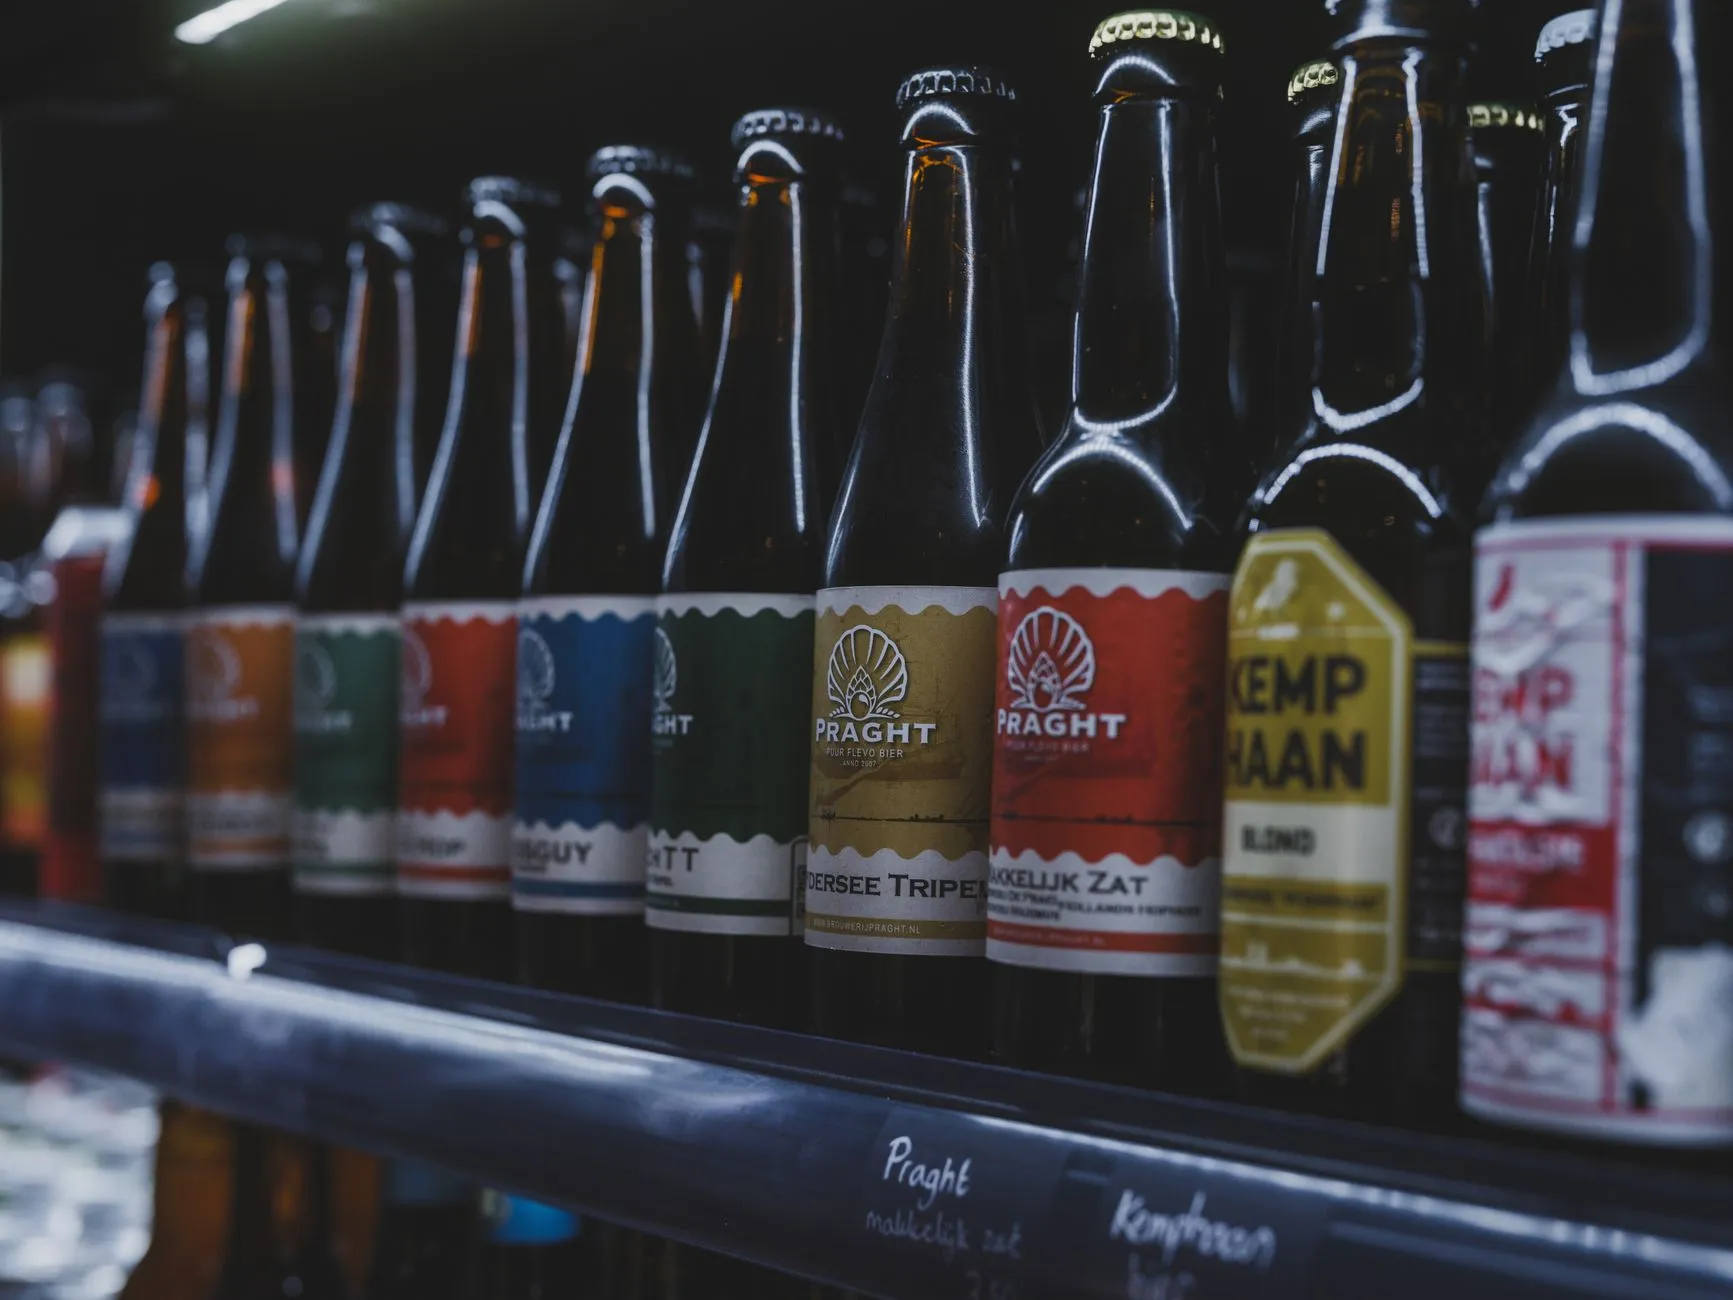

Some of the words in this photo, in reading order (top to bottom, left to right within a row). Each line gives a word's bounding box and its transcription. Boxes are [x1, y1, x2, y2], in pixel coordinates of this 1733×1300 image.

[815, 718, 936, 744] PRAGHT
[997, 708, 1127, 740] PRAGHT
[847, 748, 875, 757] FLEVO
[879, 748, 904, 758] BIER
[807, 872, 881, 896] DERSEE
[1087, 871, 1149, 896] ZAT
[882, 1136, 971, 1211] Praght
[866, 1209, 969, 1266] makkelijk
